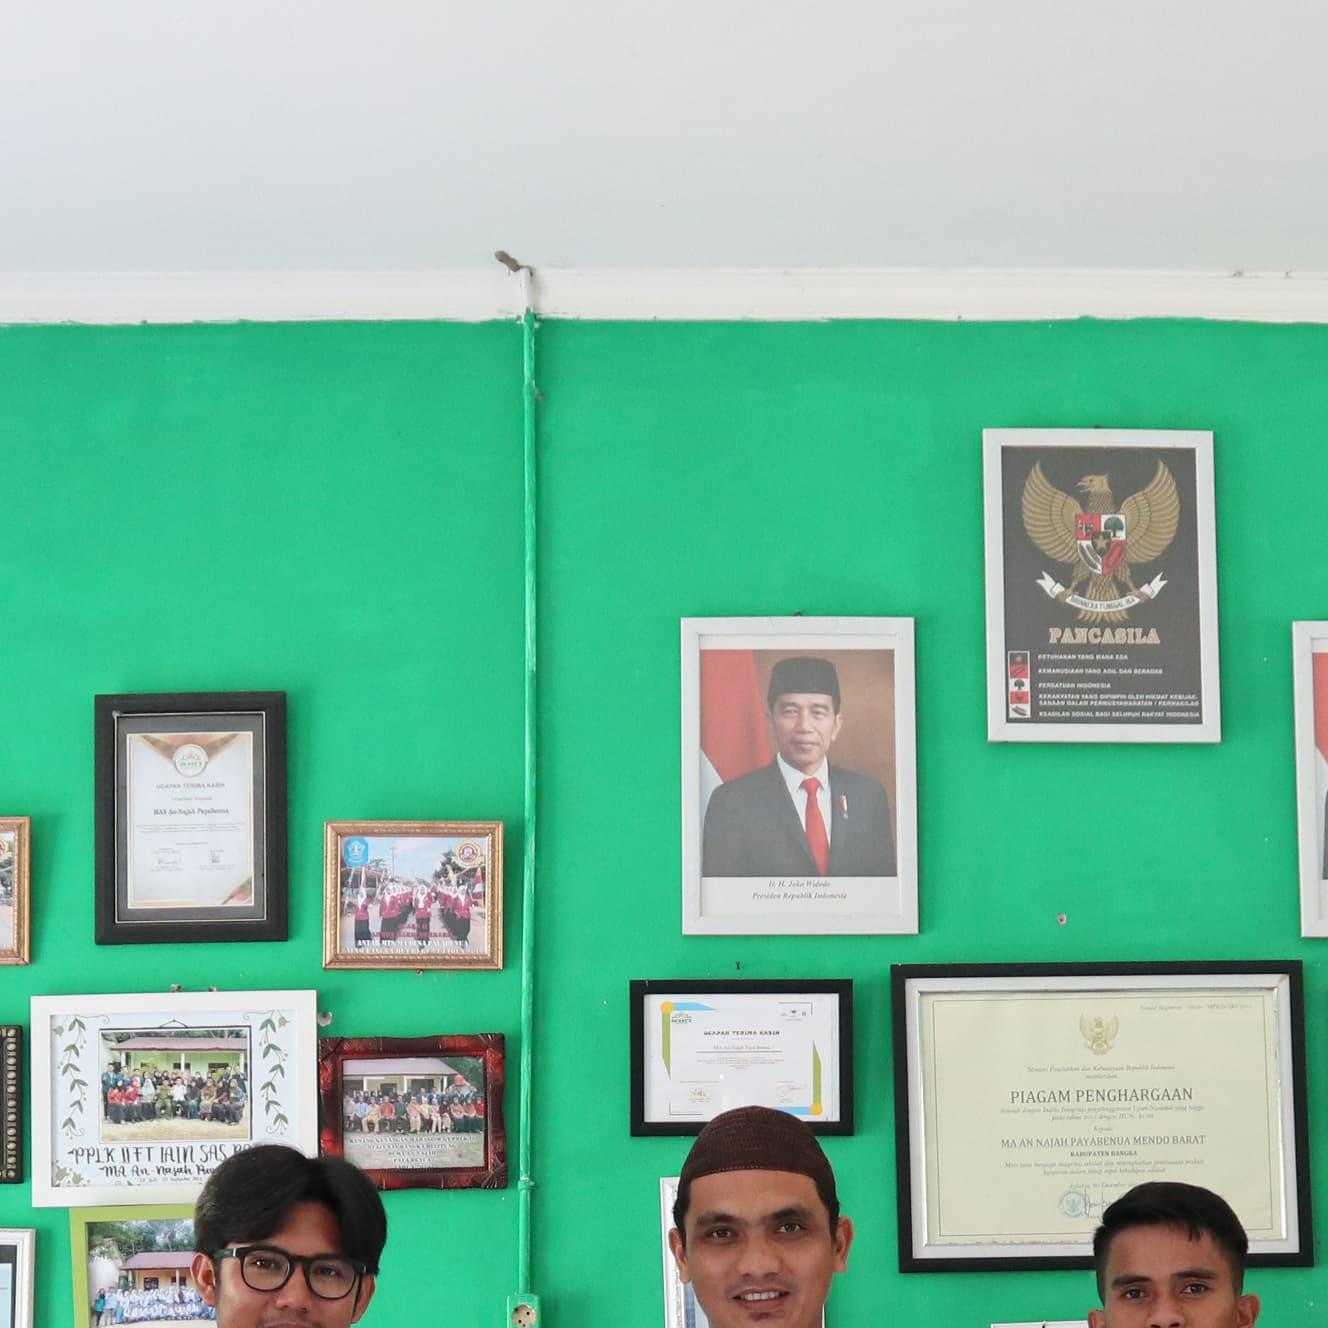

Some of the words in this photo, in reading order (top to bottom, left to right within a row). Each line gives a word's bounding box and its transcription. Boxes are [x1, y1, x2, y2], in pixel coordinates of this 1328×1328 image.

[1049, 628, 1160, 644] PANCASILA
[1011, 1090, 1070, 1104] PIAGAM
[1076, 1088, 1193, 1102] PENGHARGAAN
[1001, 1139, 1016, 1148] MA
[1020, 1139, 1034, 1147] AN
[1036, 1138, 1067, 1148] NAJAH
[1071, 1137, 1130, 1147] PAYABENUA
[1133, 1136, 1170, 1146] MENDO
[1173, 1135, 1205, 1145] BARAT
[68, 1148, 118, 1164] PPLK
[160, 1145, 194, 1163] IAIN
[200, 1144, 227, 1162] SAS
[99, 1166, 126, 1177] MA
